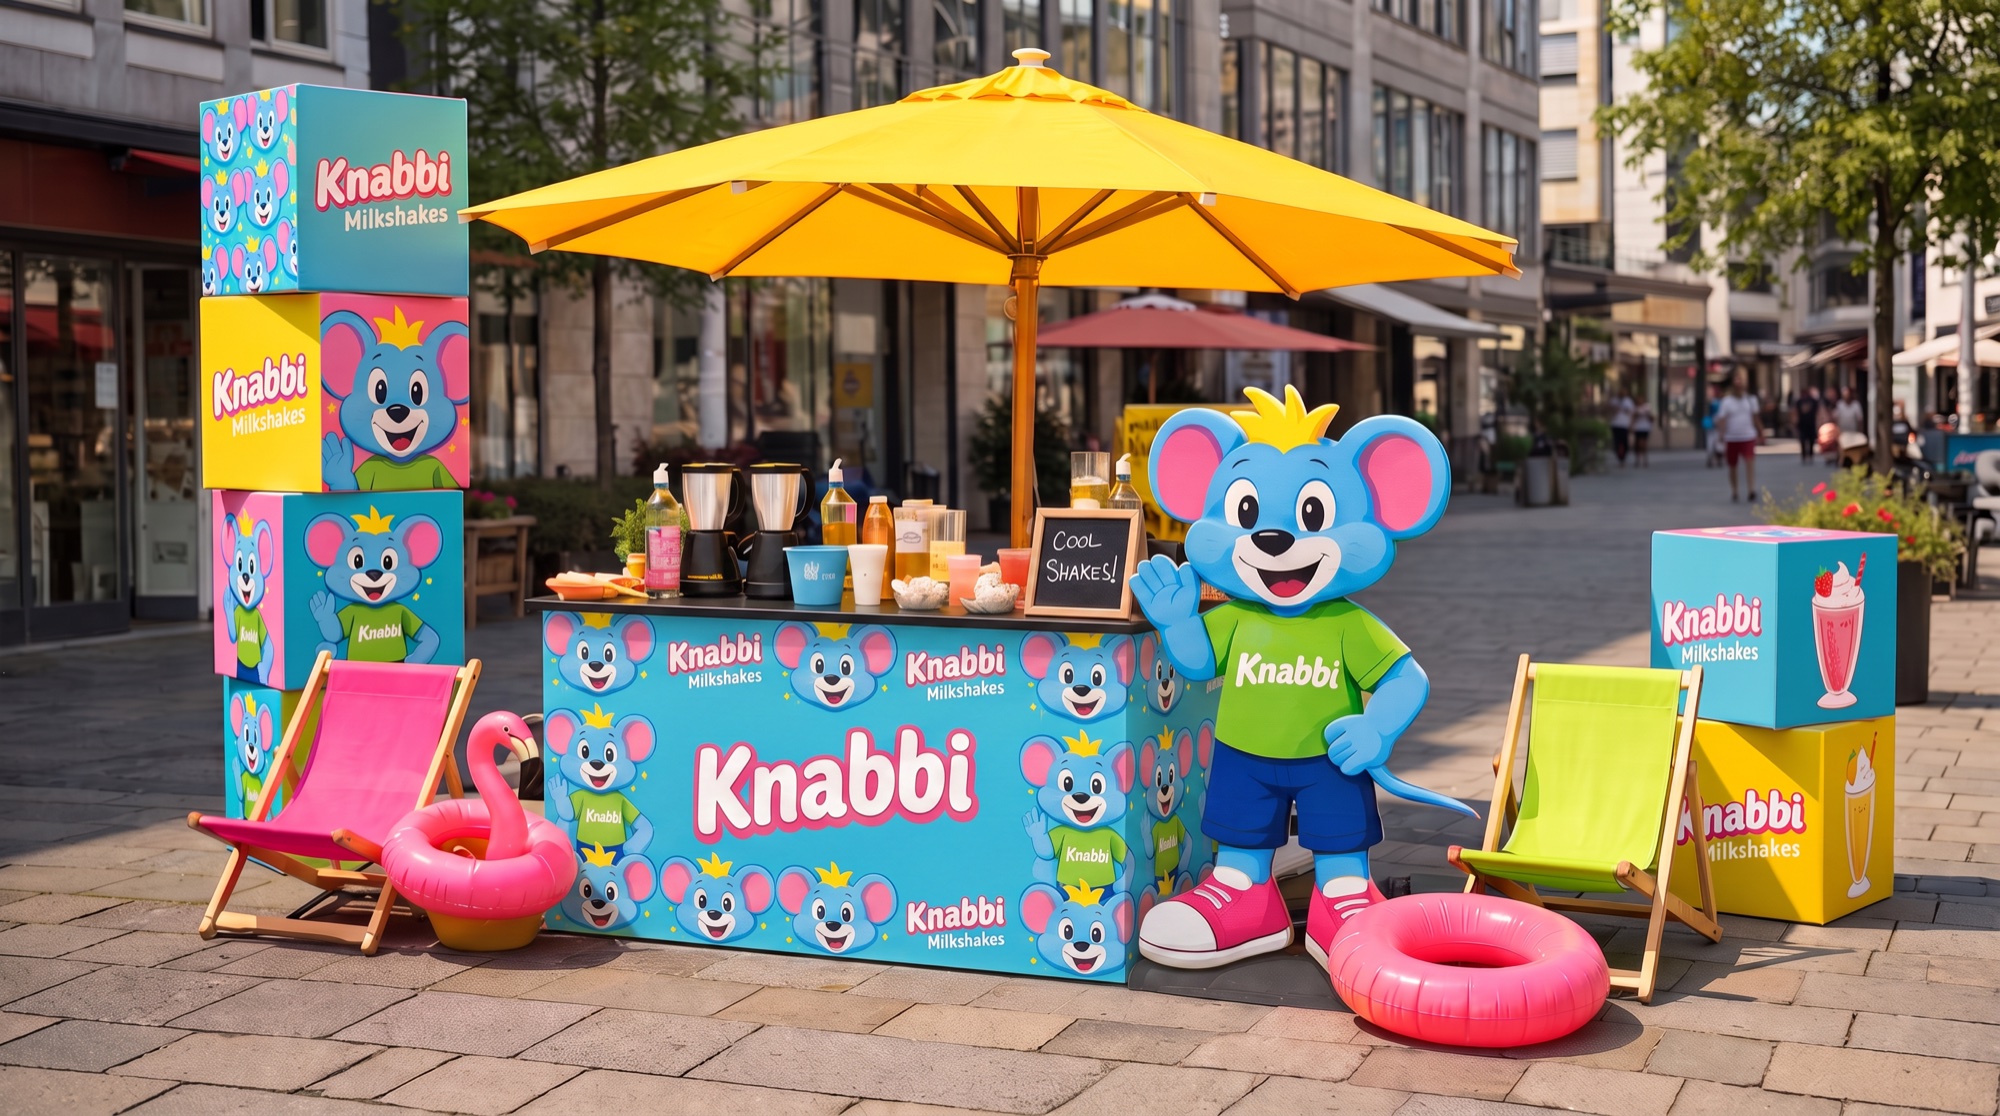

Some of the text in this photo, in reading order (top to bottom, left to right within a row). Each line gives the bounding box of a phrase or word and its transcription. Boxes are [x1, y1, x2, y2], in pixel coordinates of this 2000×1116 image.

[315, 149, 452, 212] Knabbi
[345, 204, 448, 232] Milkshakes
[212, 353, 307, 420] Knabbi
[232, 407, 306, 437] Milkshakes
[1053, 531, 1102, 551] COOL
[1047, 555, 1118, 584] SHAKES!
[1662, 593, 1762, 647] Knabbi
[667, 633, 762, 676] Knabbi
[906, 644, 1006, 688] Knabbi
[1681, 641, 1759, 664] Milkshakes
[688, 669, 762, 689] Milkshakes
[1235, 652, 1340, 690] Knabbi
[927, 680, 1005, 701] Milkshakes
[693, 725, 978, 844] Knabbi
[1066, 846, 1109, 864] Knabbi
[907, 895, 1006, 936] Knabbi
[928, 932, 1006, 950] Milkshakes
